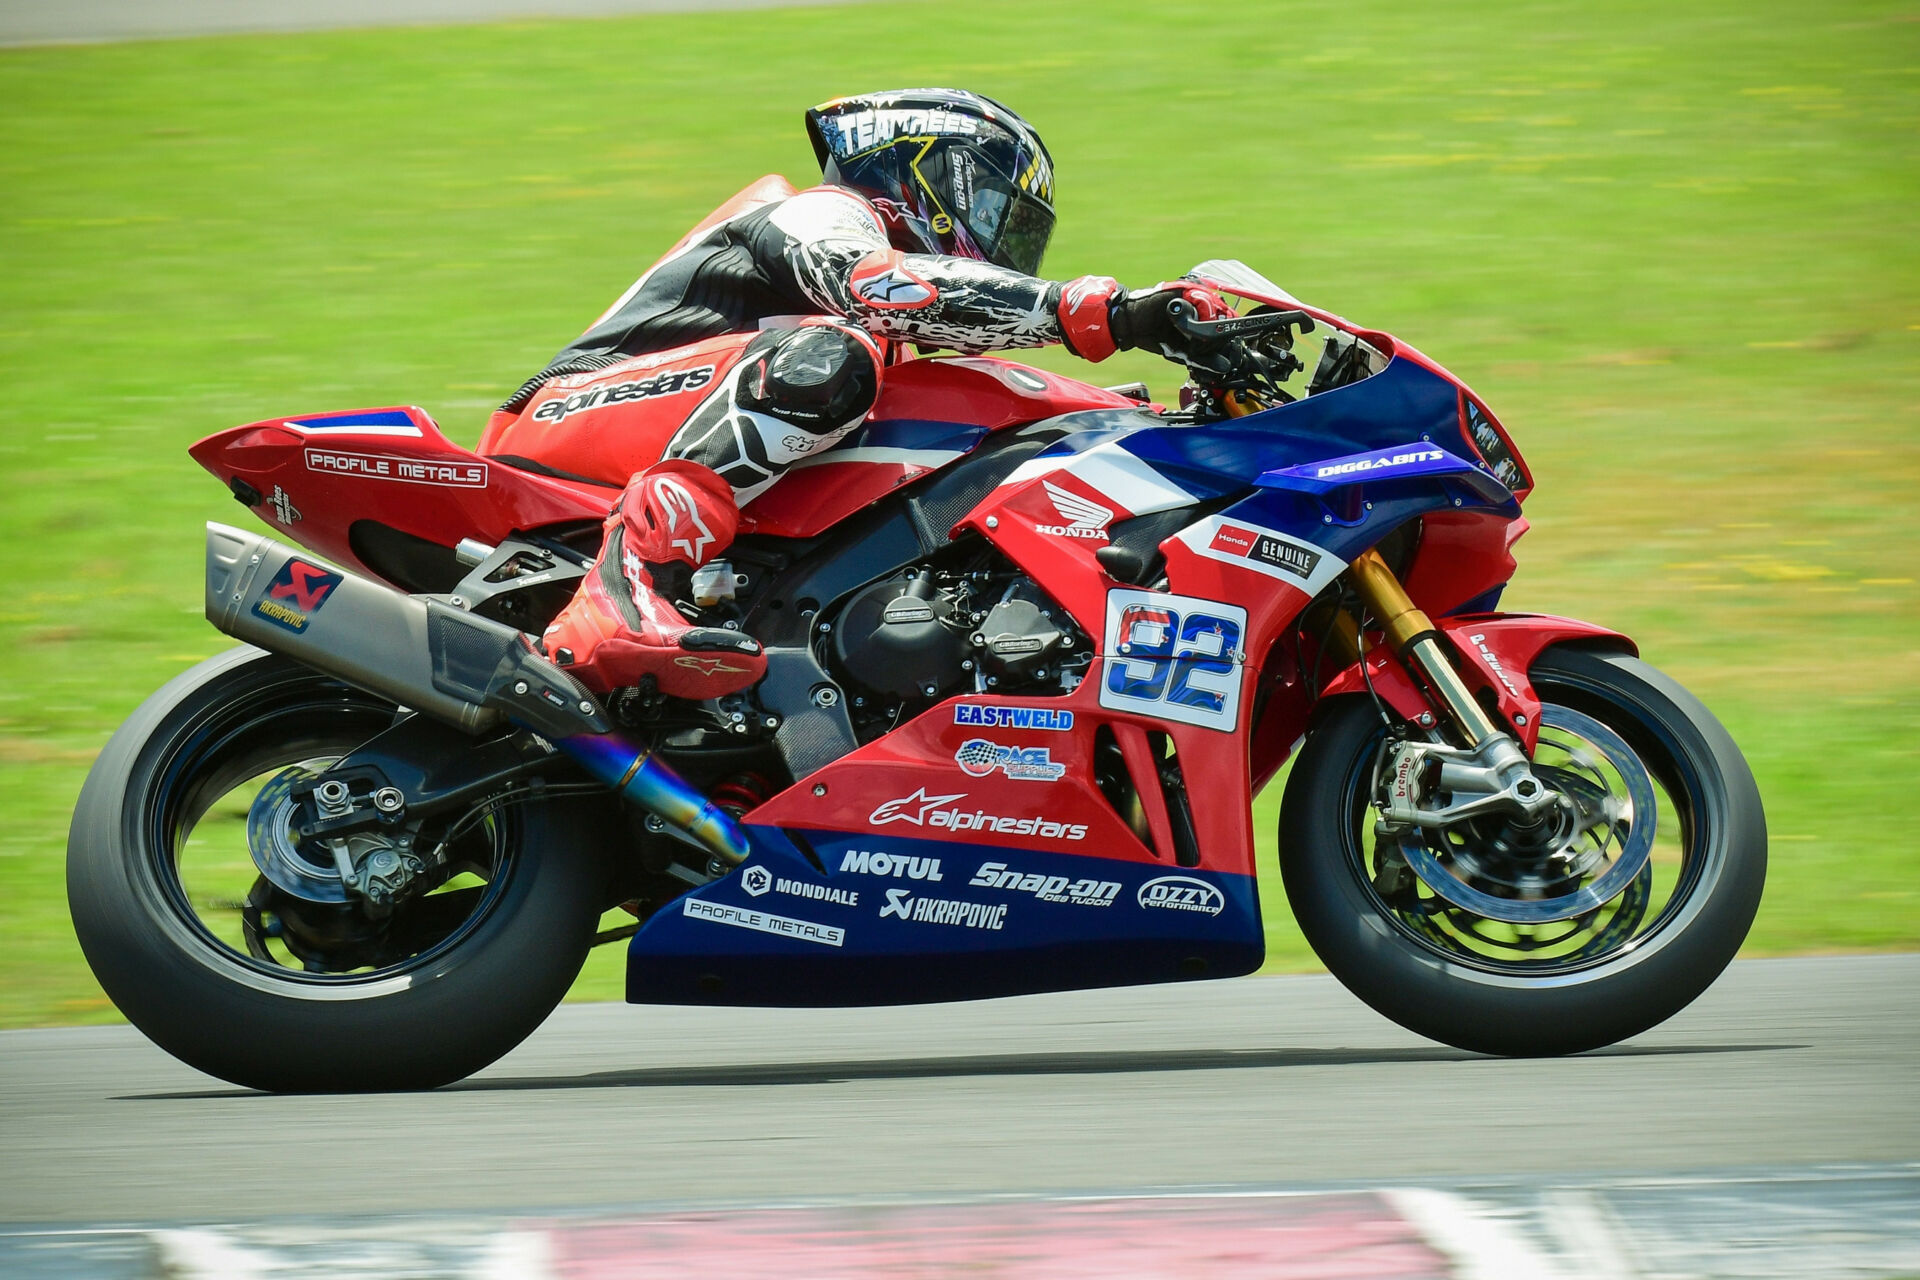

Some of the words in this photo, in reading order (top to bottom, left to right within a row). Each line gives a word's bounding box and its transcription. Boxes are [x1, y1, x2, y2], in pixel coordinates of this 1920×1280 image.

[951, 152, 967, 210] Snap-on
[859, 312, 1039, 347] alpinestars
[533, 364, 716, 424] alpinestars
[310, 454, 390, 475] PROFILE
[398, 461, 482, 483] METALS
[1318, 450, 1444, 478] DIGGABITS
[1035, 524, 1110, 541] HONDA
[1218, 533, 1249, 547] Honda
[1261, 540, 1311, 569] GENUINE
[1105, 605, 1241, 717] 92
[956, 705, 1073, 730] EASTWELD
[996, 748, 1047, 765] RACE
[1395, 757, 1411, 797] brembo
[928, 809, 1089, 840] alpinestars
[839, 850, 944, 882] MOTUL
[969, 861, 1122, 899] Snap-on
[775, 878, 860, 906] MONDIALE
[1070, 895, 1113, 907] TUDOR
[1141, 896, 1221, 914] Performance
[1150, 884, 1215, 906] OZZY
[689, 902, 762, 925] PROFILE
[767, 918, 840, 942] METALS
